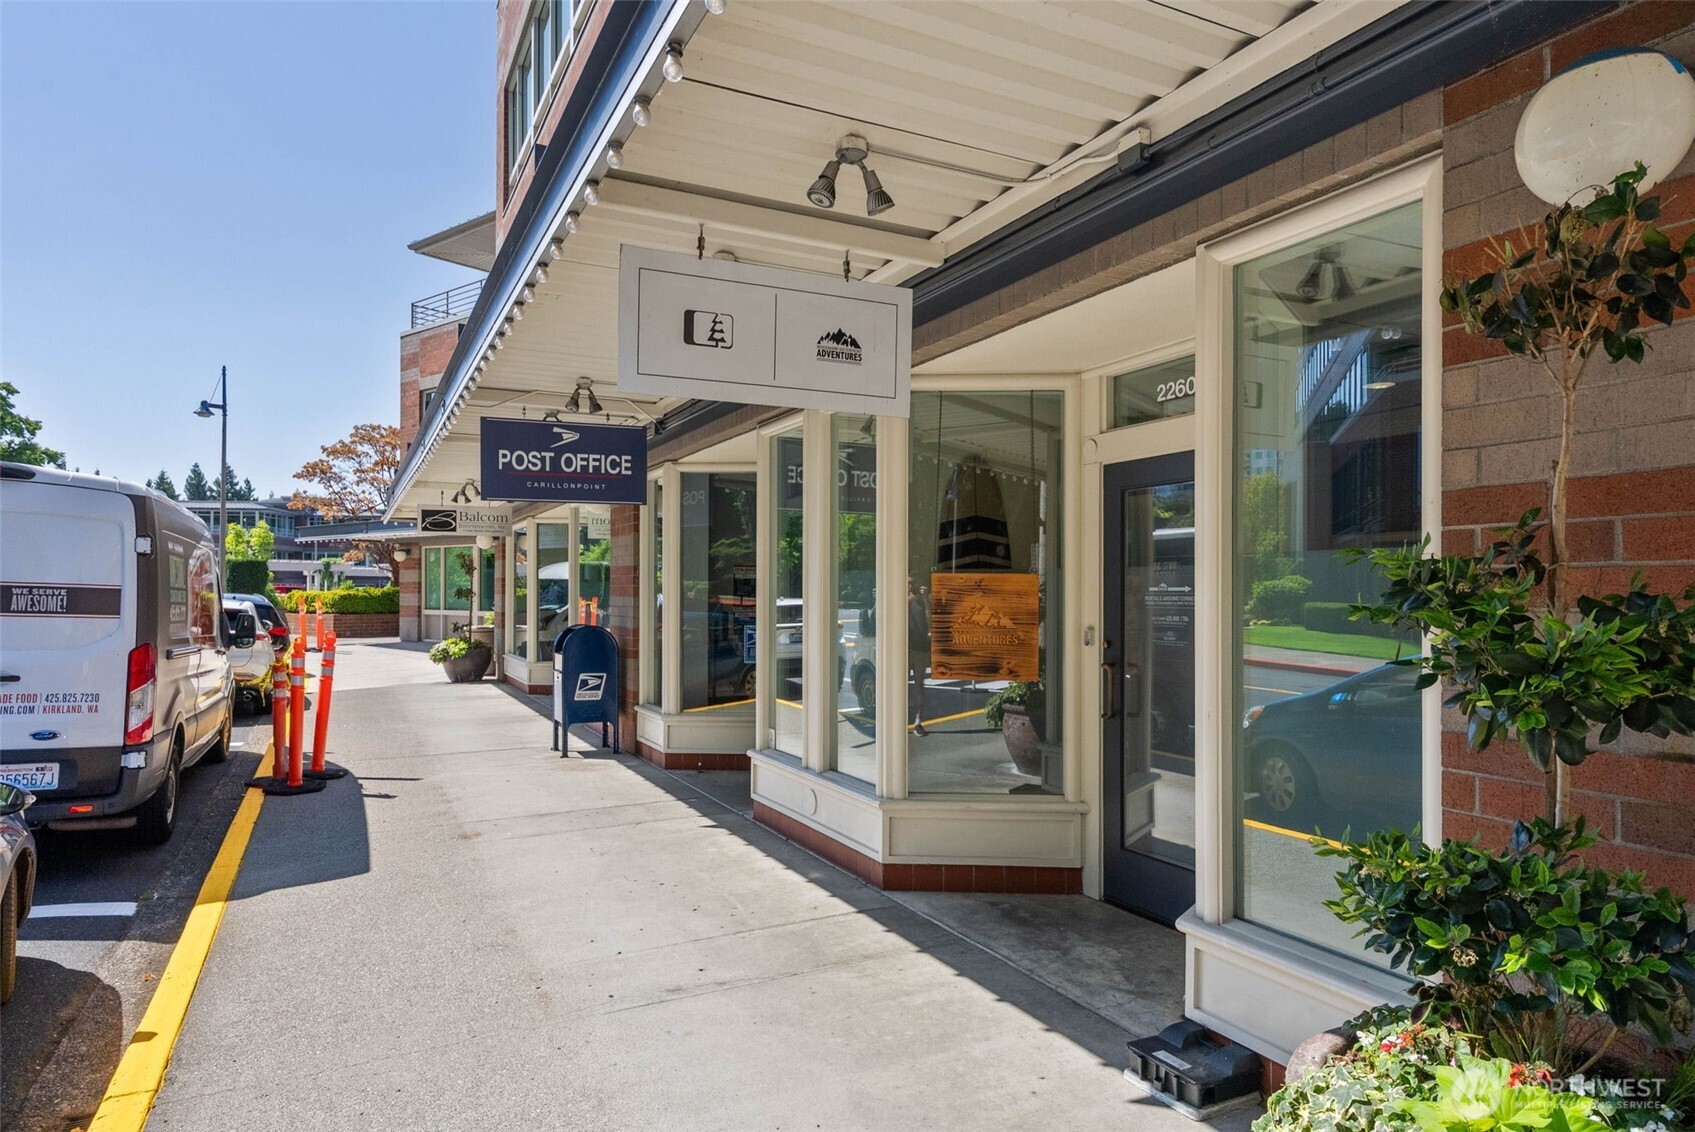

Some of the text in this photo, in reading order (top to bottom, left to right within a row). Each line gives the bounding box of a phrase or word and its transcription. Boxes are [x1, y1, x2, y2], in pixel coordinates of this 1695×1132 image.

[816, 349, 862, 362] ADVENTURES
[1157, 376, 1195, 402] 2260
[498, 449, 632, 475] POST OFFICE
[526, 481, 606, 490] CARILLONPOINT
[459, 511, 508, 523] Balcom
[12, 587, 68, 596] WE SERVE
[10, 594, 68, 612] AWESOME!
[16, 693, 38, 704] FOOD
[44, 693, 100, 703] 425.825.7230
[87, 704, 99, 714] WA
